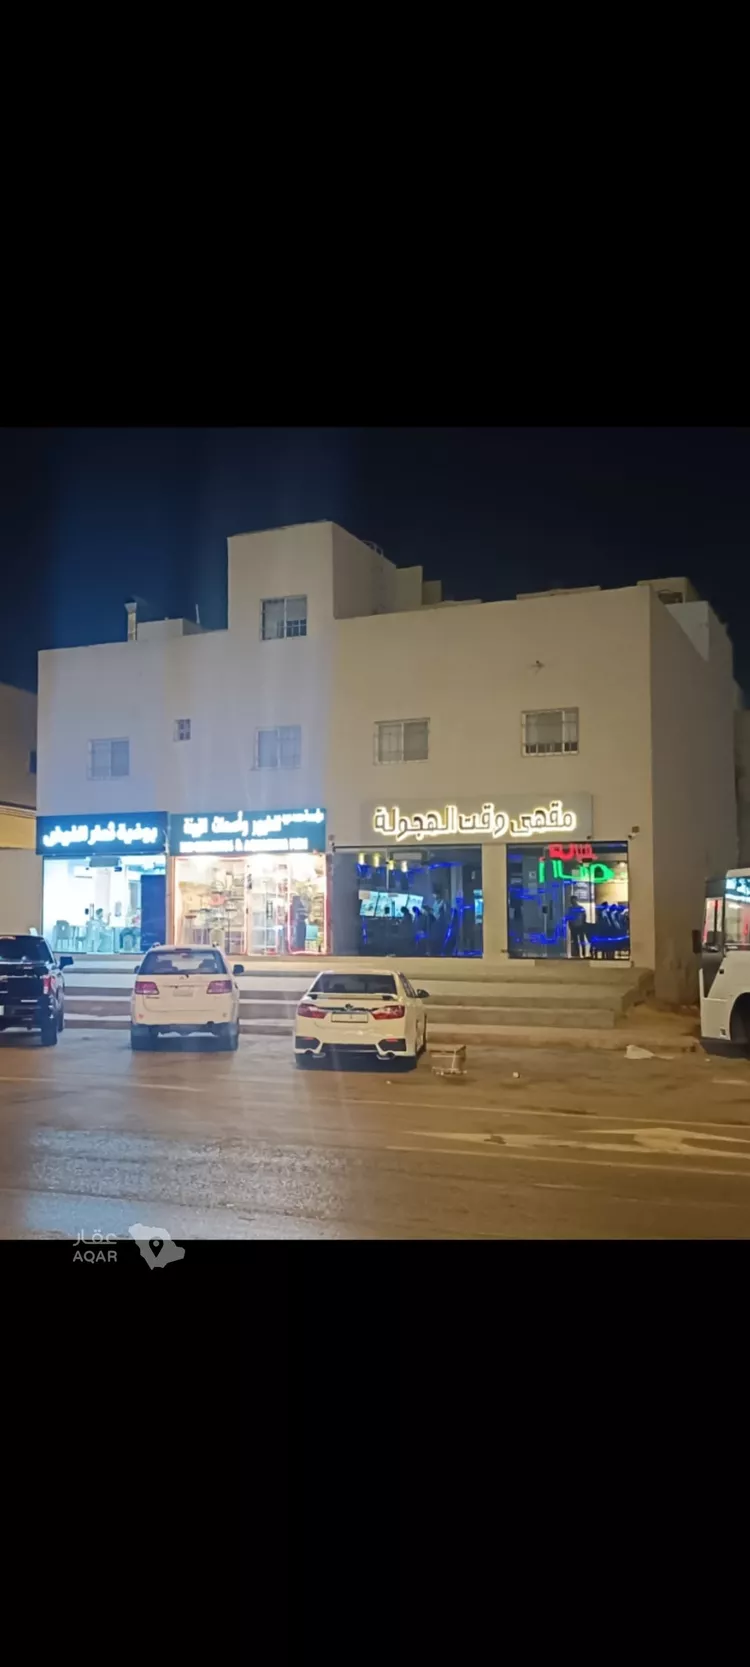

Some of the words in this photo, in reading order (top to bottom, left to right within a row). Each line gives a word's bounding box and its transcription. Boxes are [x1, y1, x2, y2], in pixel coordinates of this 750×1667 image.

[373, 804, 457, 841] الهجولة
[458, 803, 509, 838] وقت
[510, 800, 576, 836] مقهى
